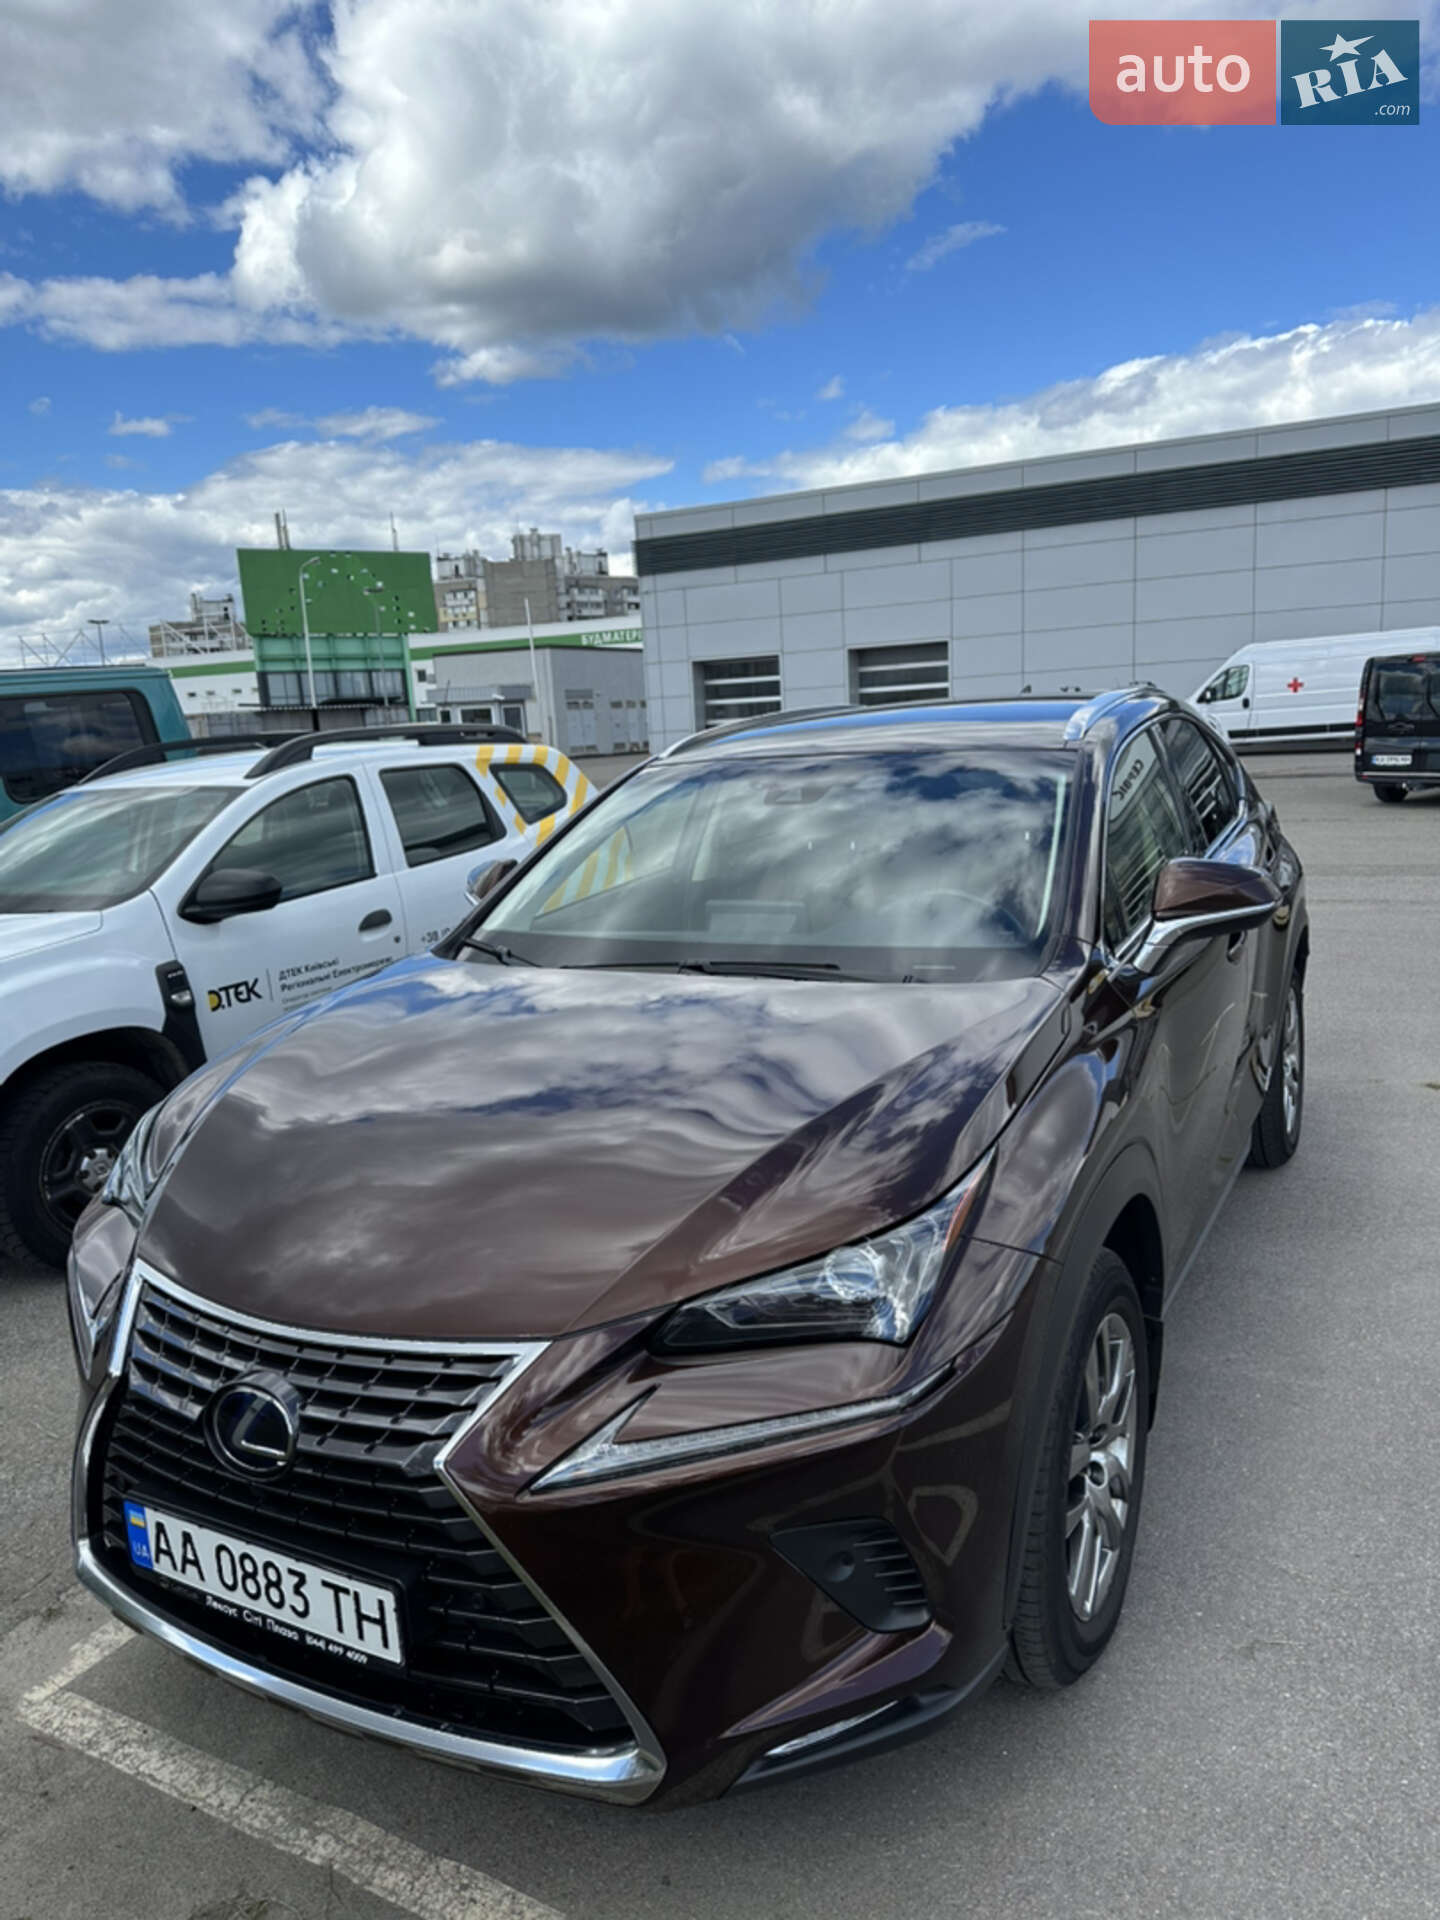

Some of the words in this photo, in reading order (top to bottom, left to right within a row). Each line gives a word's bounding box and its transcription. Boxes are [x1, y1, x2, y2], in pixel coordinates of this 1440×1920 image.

[154, 1520, 206, 1583] AA
[214, 1543, 310, 1619] 0883
[320, 1578, 390, 1650] TH
